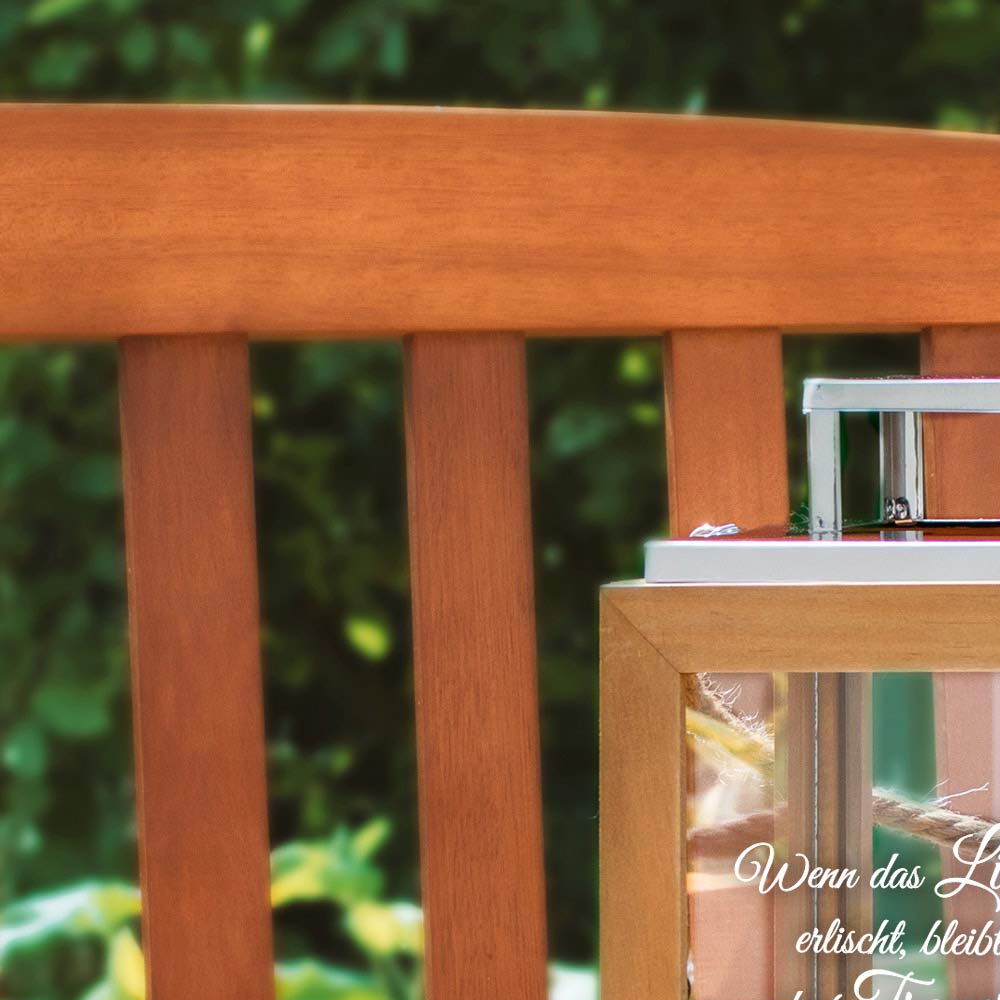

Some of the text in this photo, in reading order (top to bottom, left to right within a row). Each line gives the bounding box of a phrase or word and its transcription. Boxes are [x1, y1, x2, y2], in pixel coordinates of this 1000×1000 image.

[734, 842, 861, 894] Wenn
[869, 853, 925, 889] das
[796, 918, 907, 960] erlischt,
